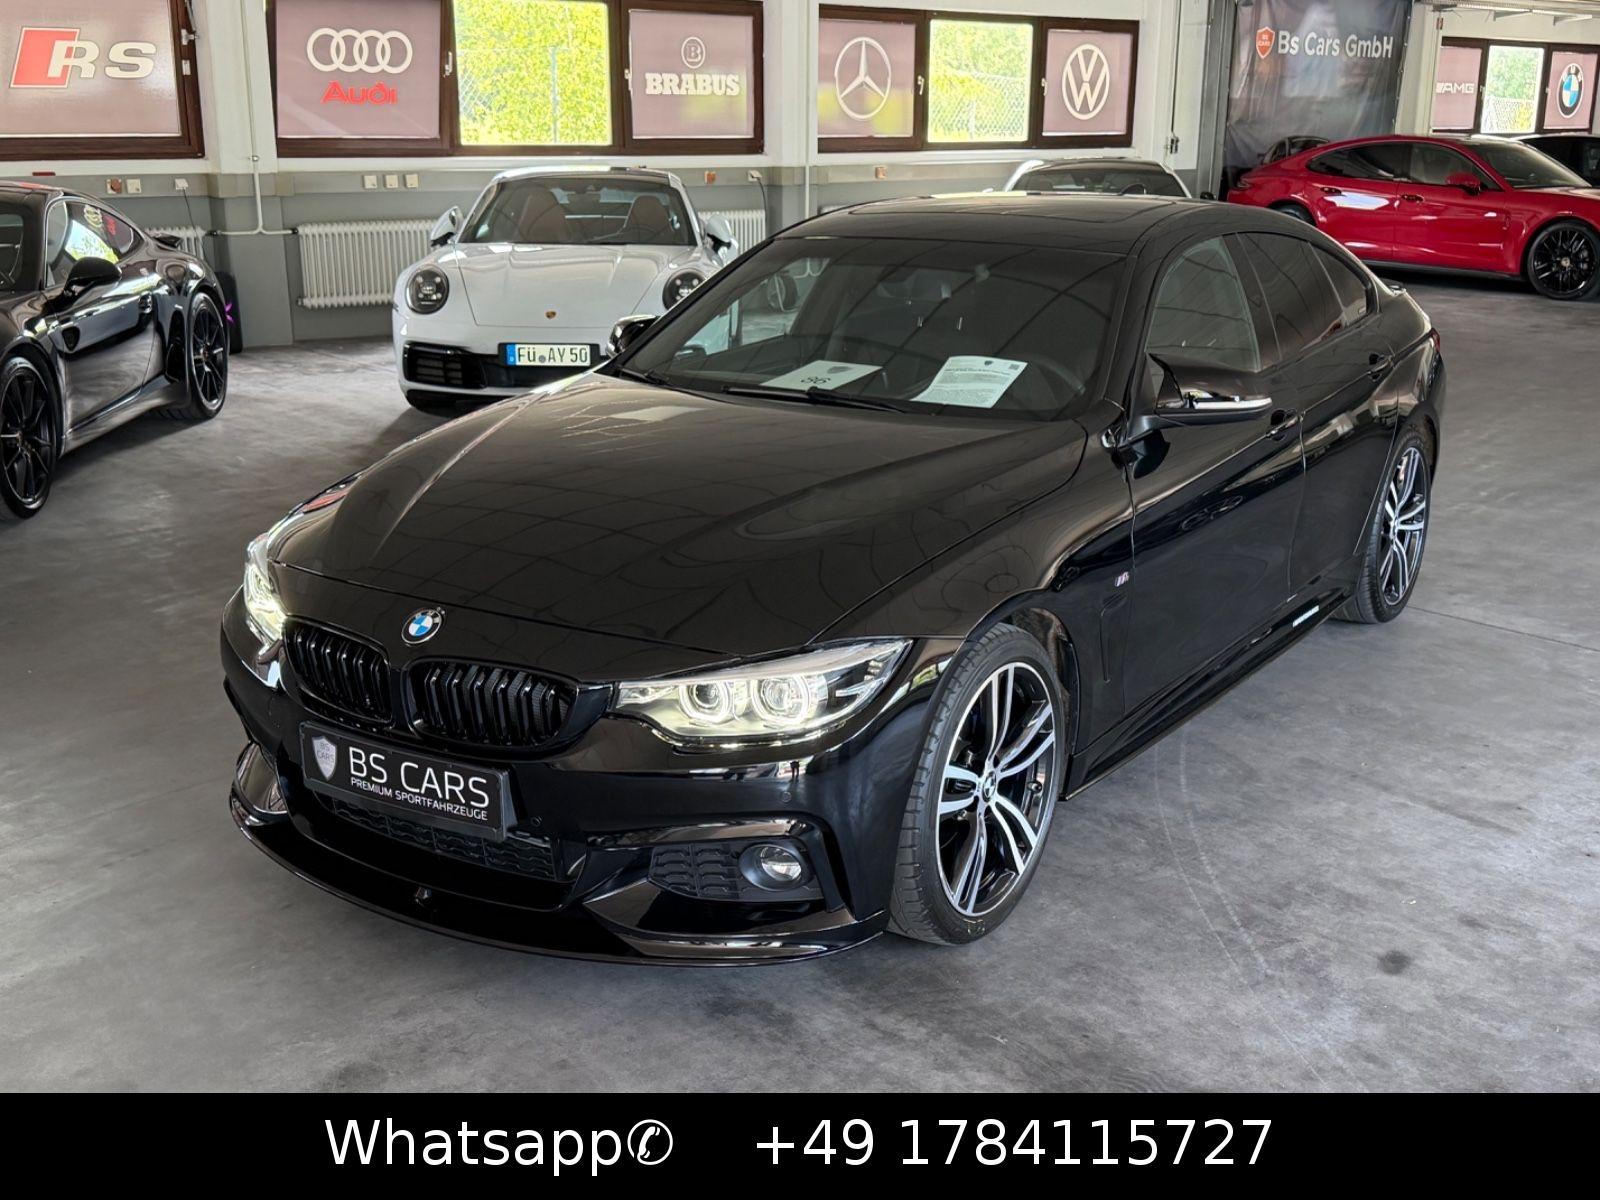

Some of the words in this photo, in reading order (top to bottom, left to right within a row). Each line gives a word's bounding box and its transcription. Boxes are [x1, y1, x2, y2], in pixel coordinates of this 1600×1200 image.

[1278, 30, 1299, 56] Bs
[1304, 31, 1340, 56] Cars
[1345, 34, 1394, 58] GmbH
[47, 40, 157, 79] RS
[320, 80, 398, 105] Audi
[645, 72, 740, 96] BRABUS
[517, 346, 537, 363] FÜ
[548, 346, 566, 363] AY
[569, 346, 588, 363] 50
[348, 746, 388, 784] BS
[400, 761, 490, 808] CARS
[350, 776, 393, 798] PREMIUM
[394, 790, 489, 821] SPORTFAHRZEUGE
